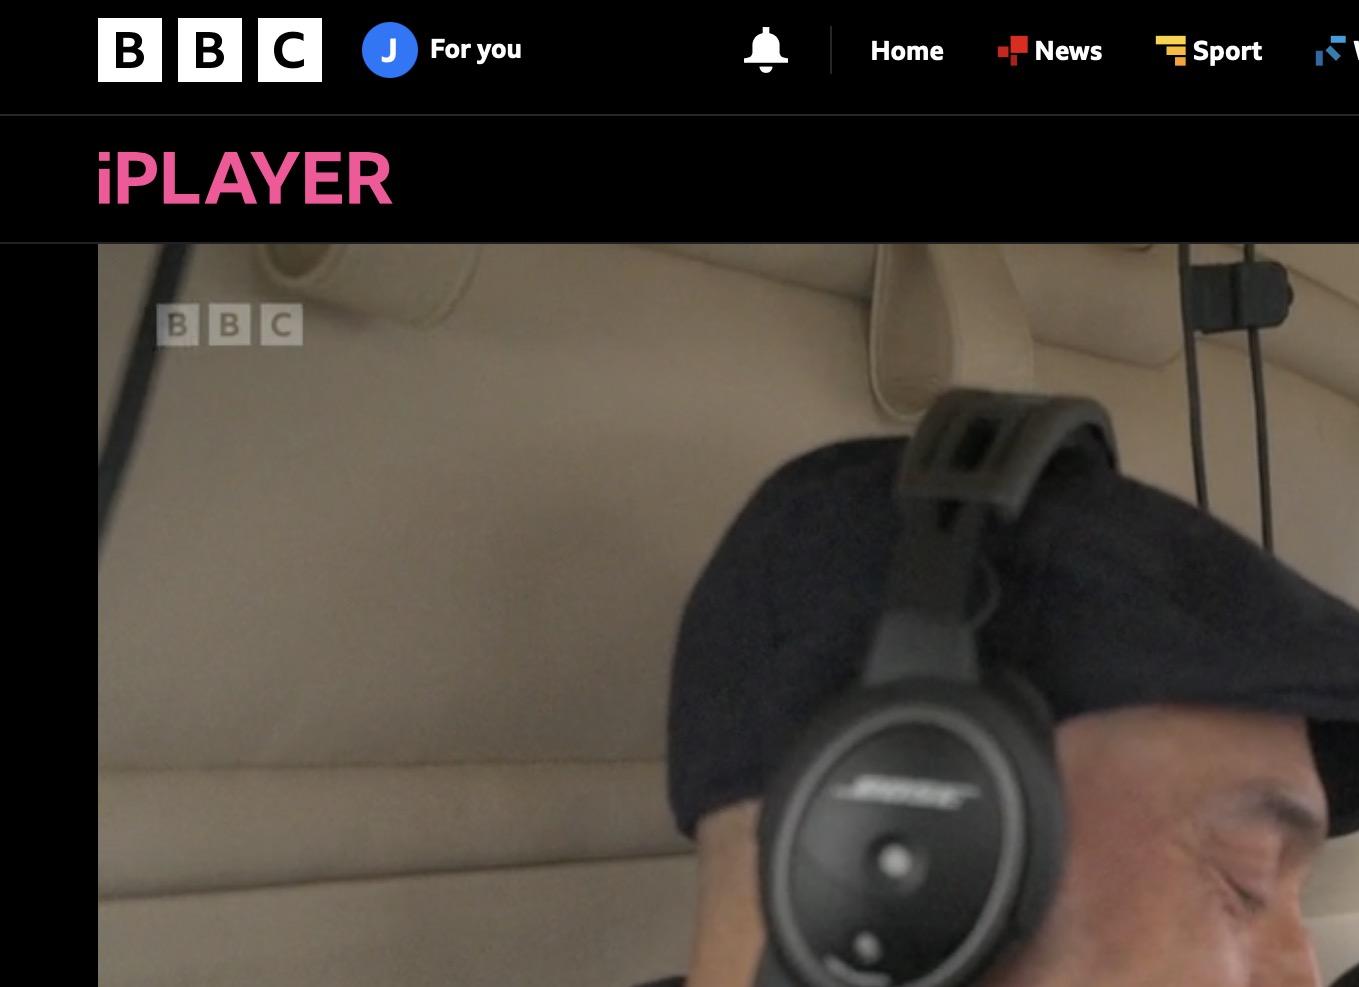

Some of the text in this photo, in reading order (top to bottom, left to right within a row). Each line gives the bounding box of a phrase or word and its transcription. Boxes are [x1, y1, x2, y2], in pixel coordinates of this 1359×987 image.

[113, 29, 307, 71] BBC
[381, 37, 397, 63] J
[431, 38, 522, 65] For you
[871, 40, 944, 62] Home
[1035, 40, 1103, 61] News
[1193, 39, 1263, 67] Sport
[98, 151, 393, 205] iPLAYER
